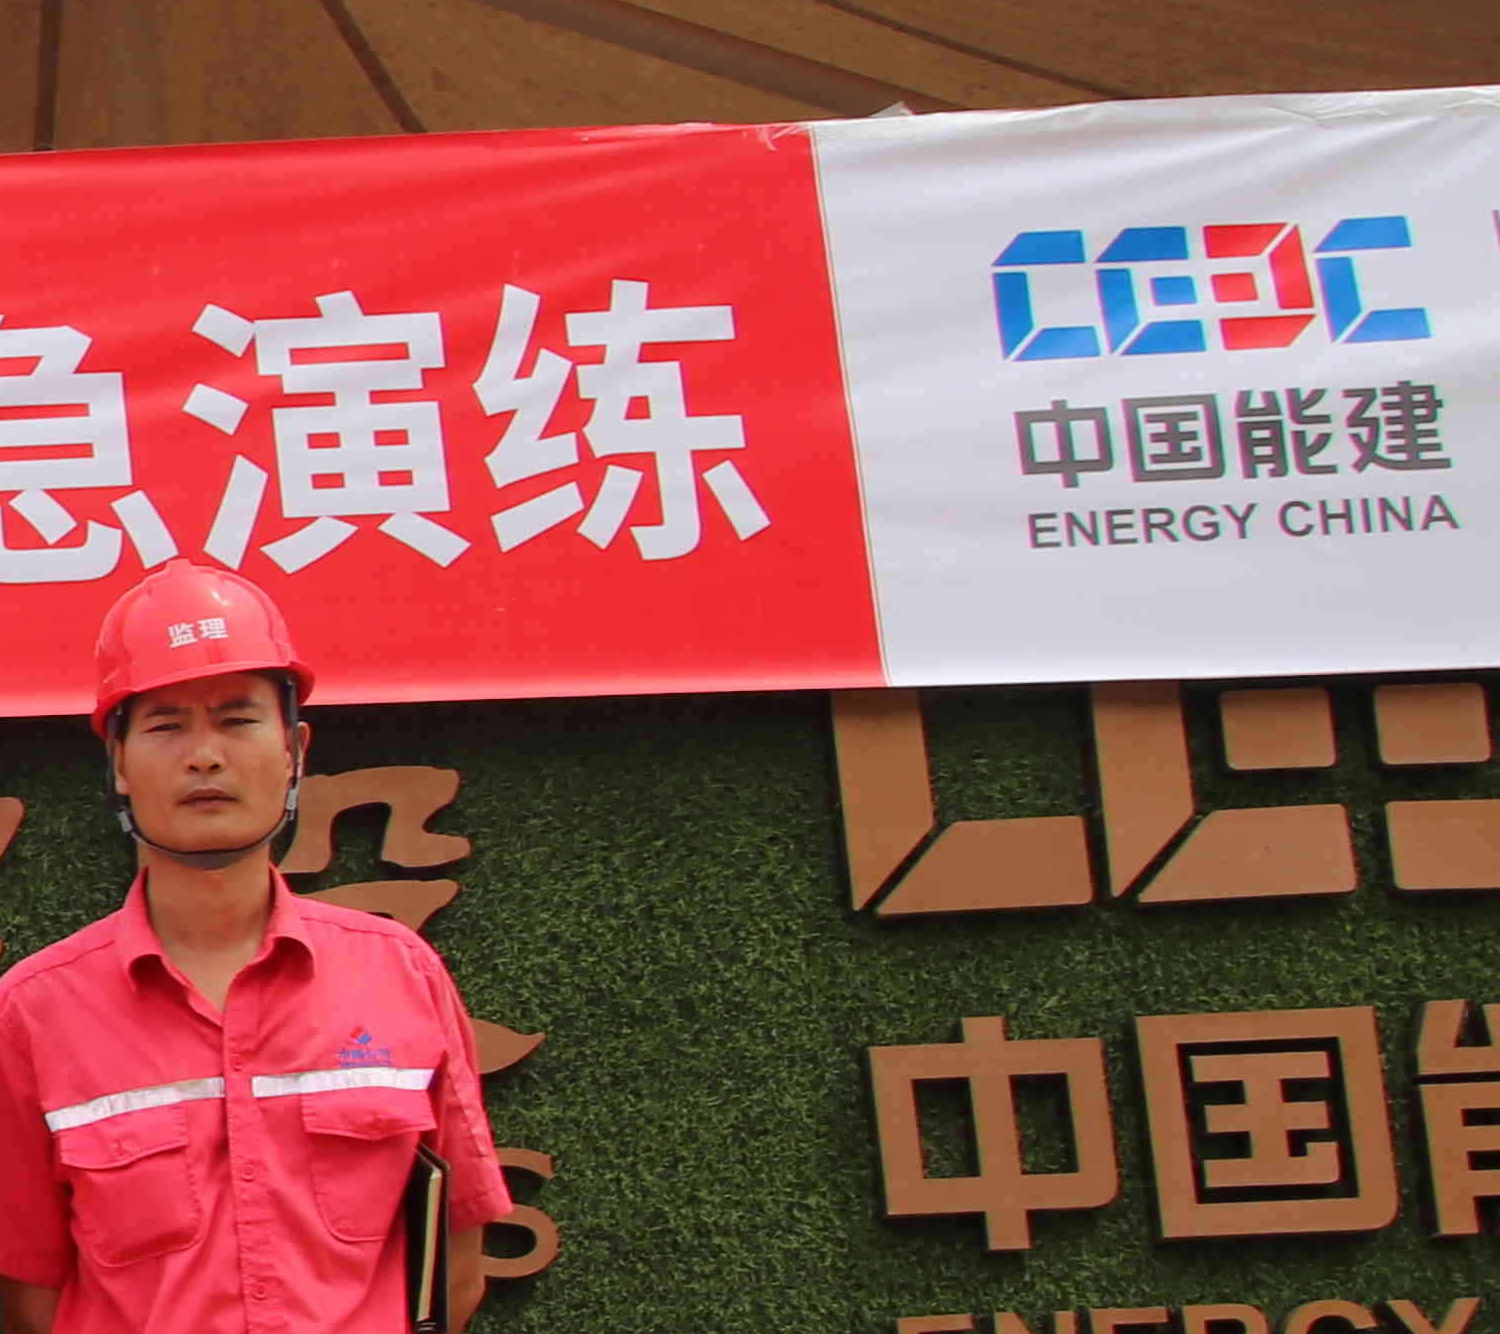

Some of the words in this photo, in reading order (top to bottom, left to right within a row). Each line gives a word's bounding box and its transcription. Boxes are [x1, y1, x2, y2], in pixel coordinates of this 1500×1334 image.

[1013, 380, 1452, 489] 中国能建
[1028, 503, 1258, 549] ENERGY
[1278, 494, 1460, 537] CHINA
[168, 618, 229, 649] 监理
